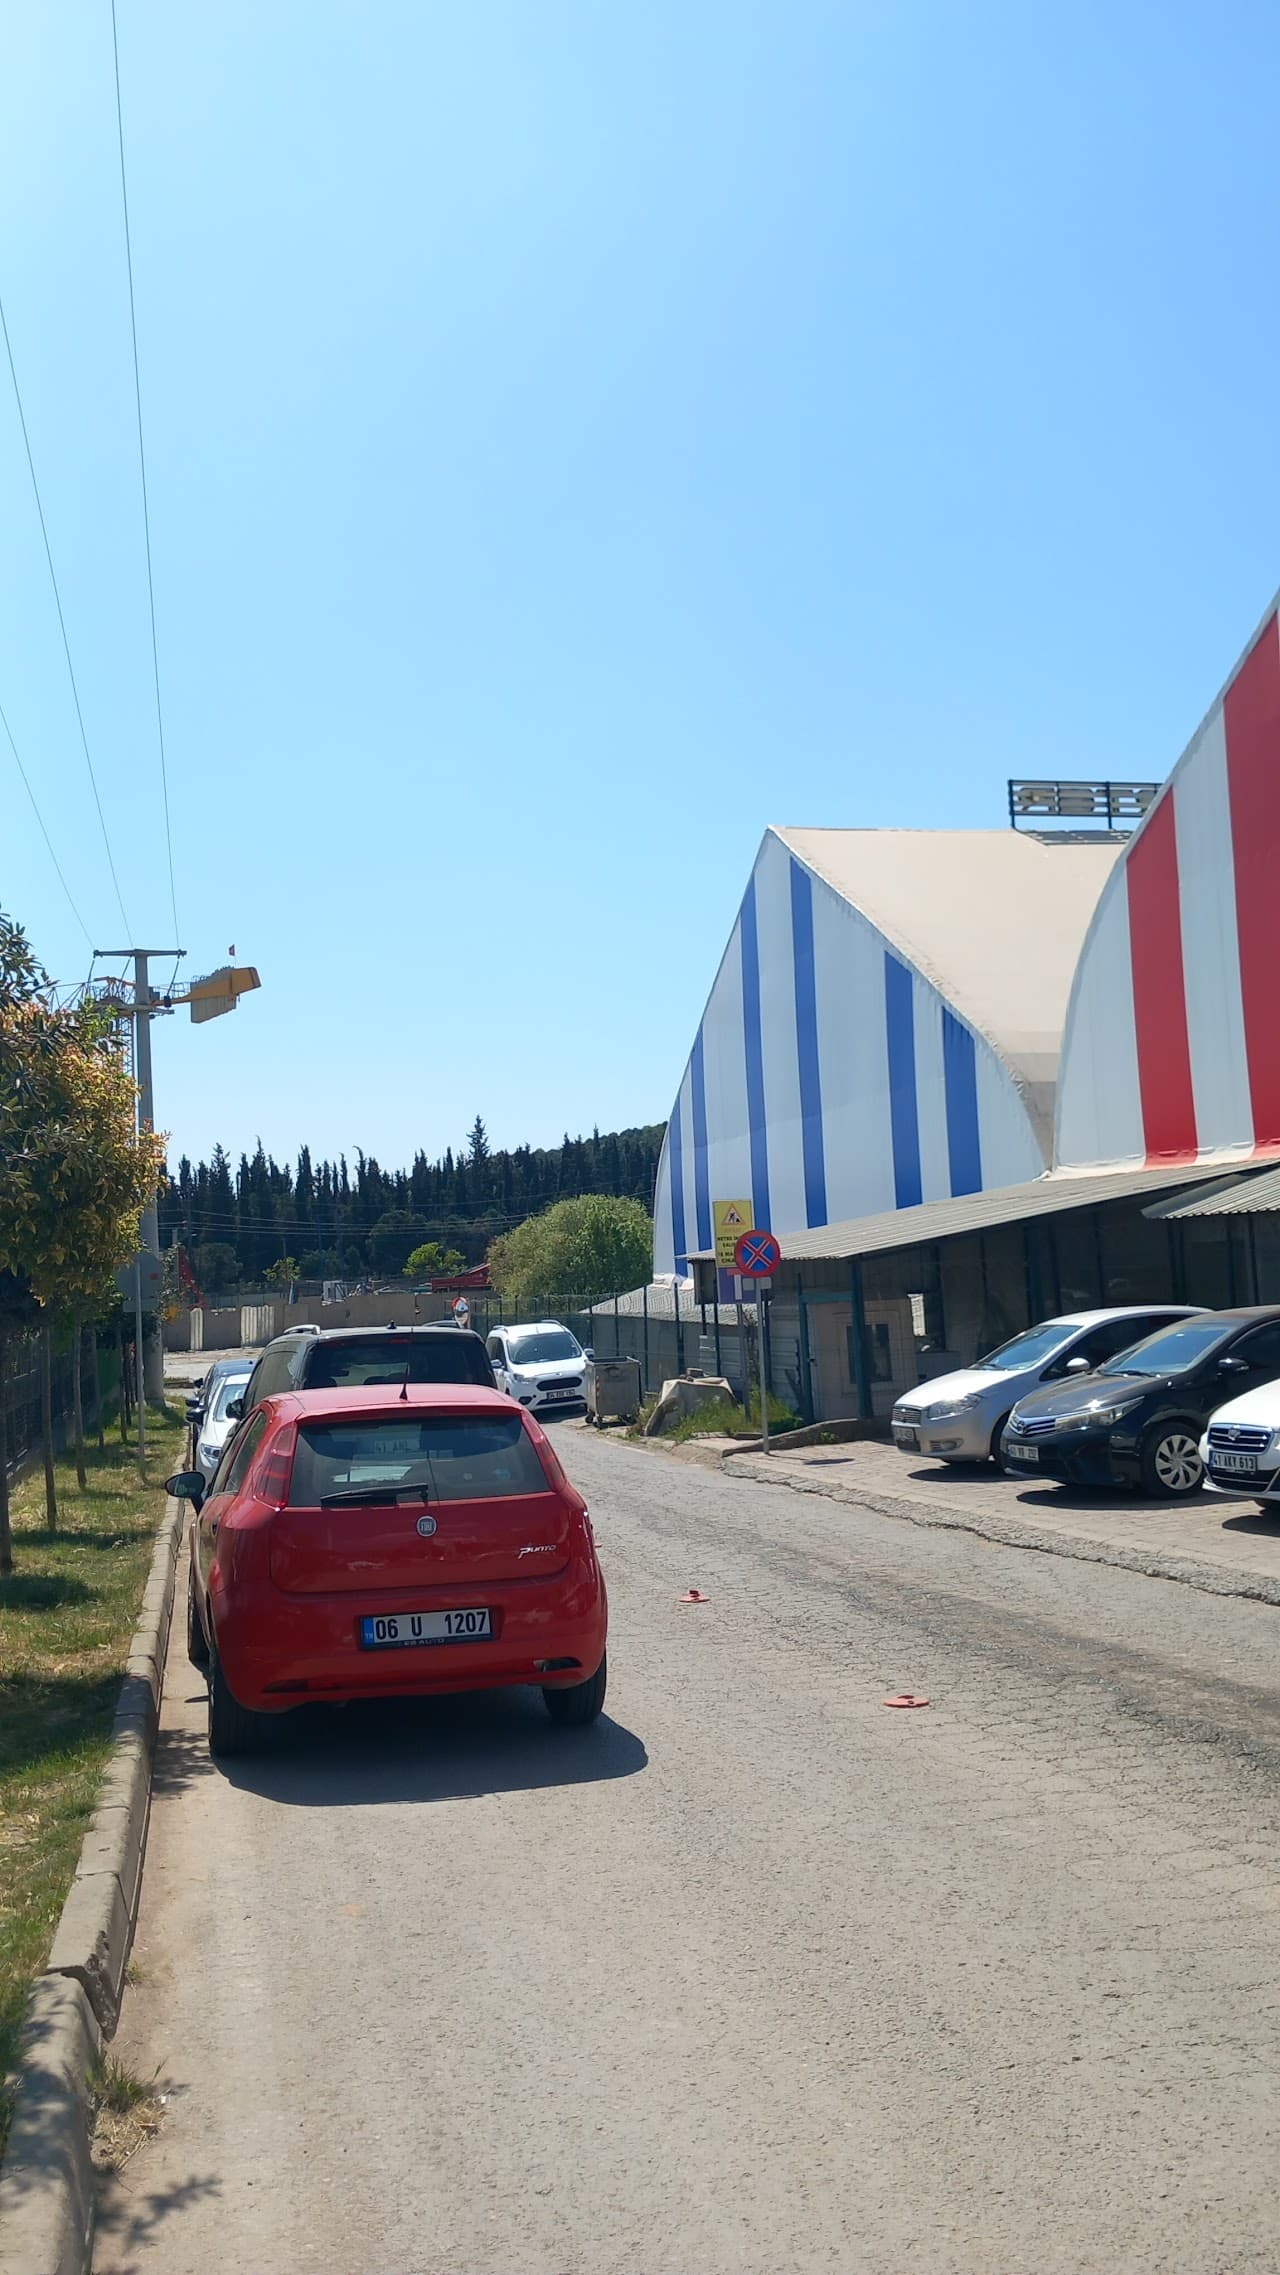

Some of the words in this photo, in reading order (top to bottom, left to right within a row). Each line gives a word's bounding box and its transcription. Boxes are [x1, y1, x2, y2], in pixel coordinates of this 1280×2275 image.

[1239, 1456, 1254, 1470] 613
[374, 1618, 399, 1641] 06
[410, 1615, 422, 1638] U
[444, 1610, 487, 1635] 1207
